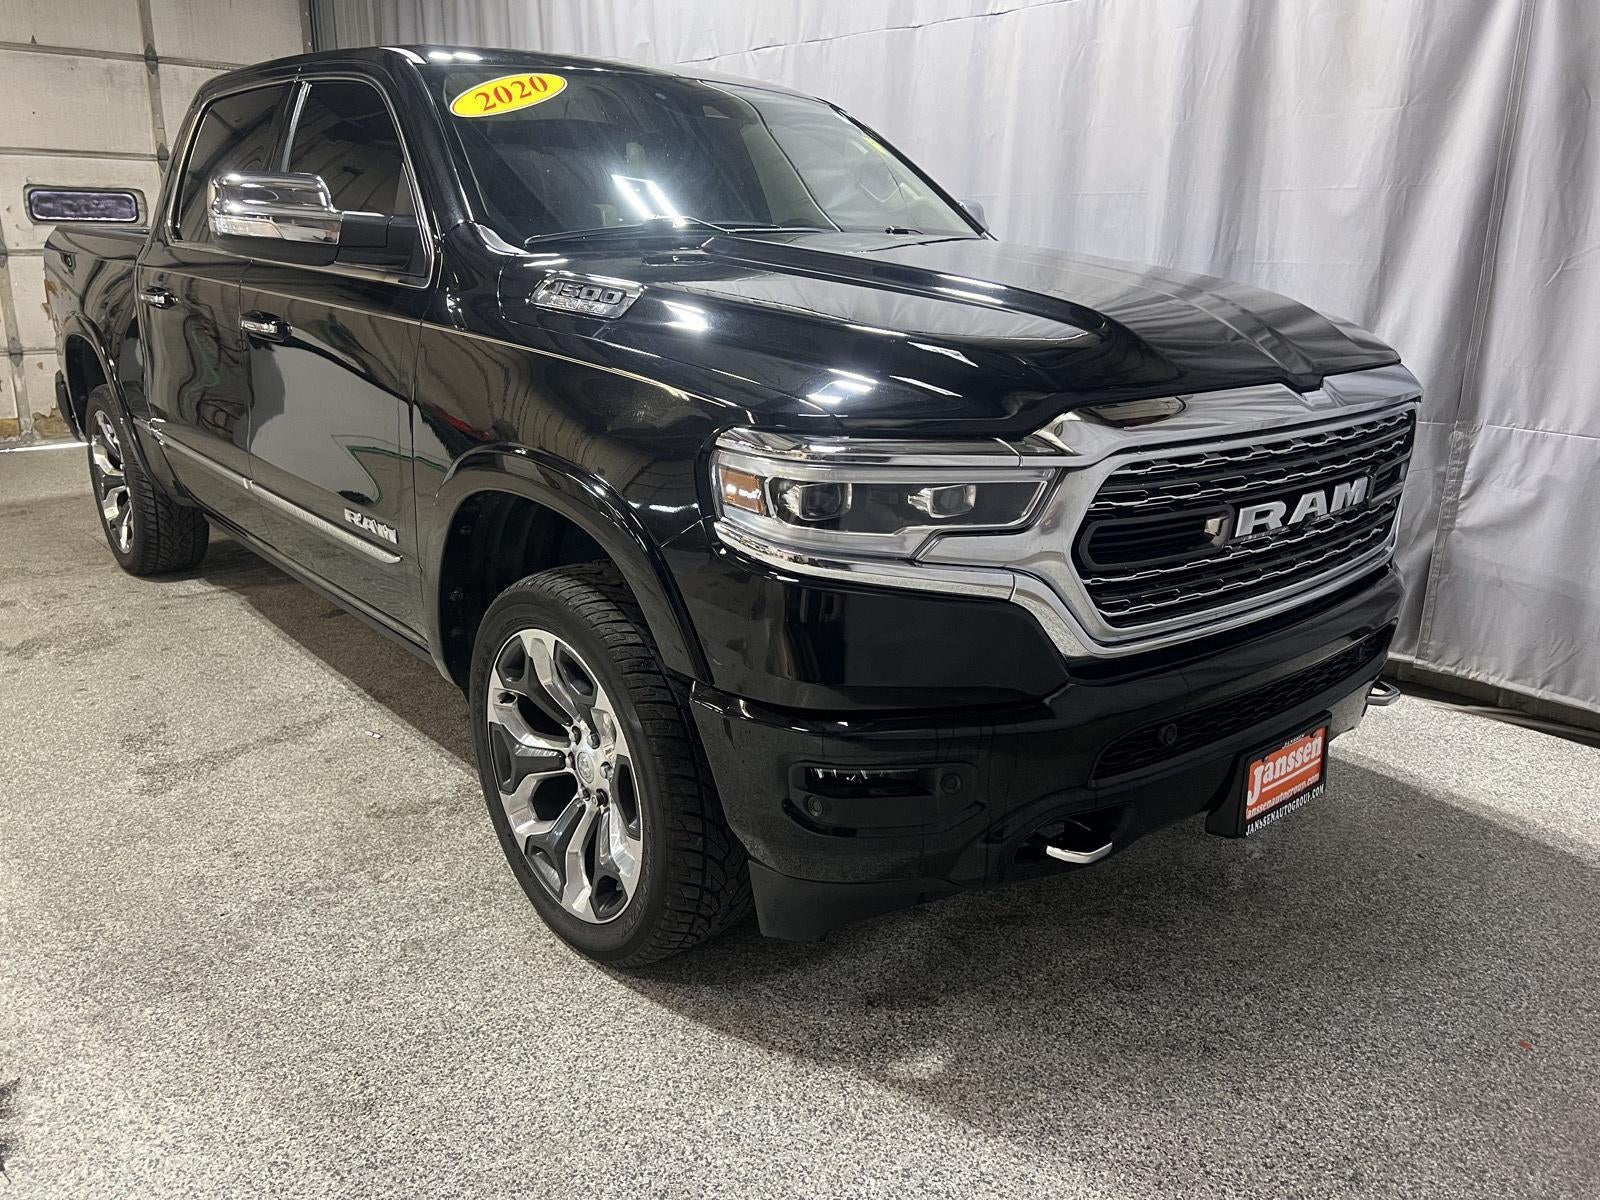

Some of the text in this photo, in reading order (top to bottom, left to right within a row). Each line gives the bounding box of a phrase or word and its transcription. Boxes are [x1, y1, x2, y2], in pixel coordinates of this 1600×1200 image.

[474, 75, 548, 112] 2020
[545, 281, 626, 305] 1500
[1234, 476, 1369, 538] RAM
[344, 508, 398, 544] RAM
[1246, 736, 1323, 807] Janssen
